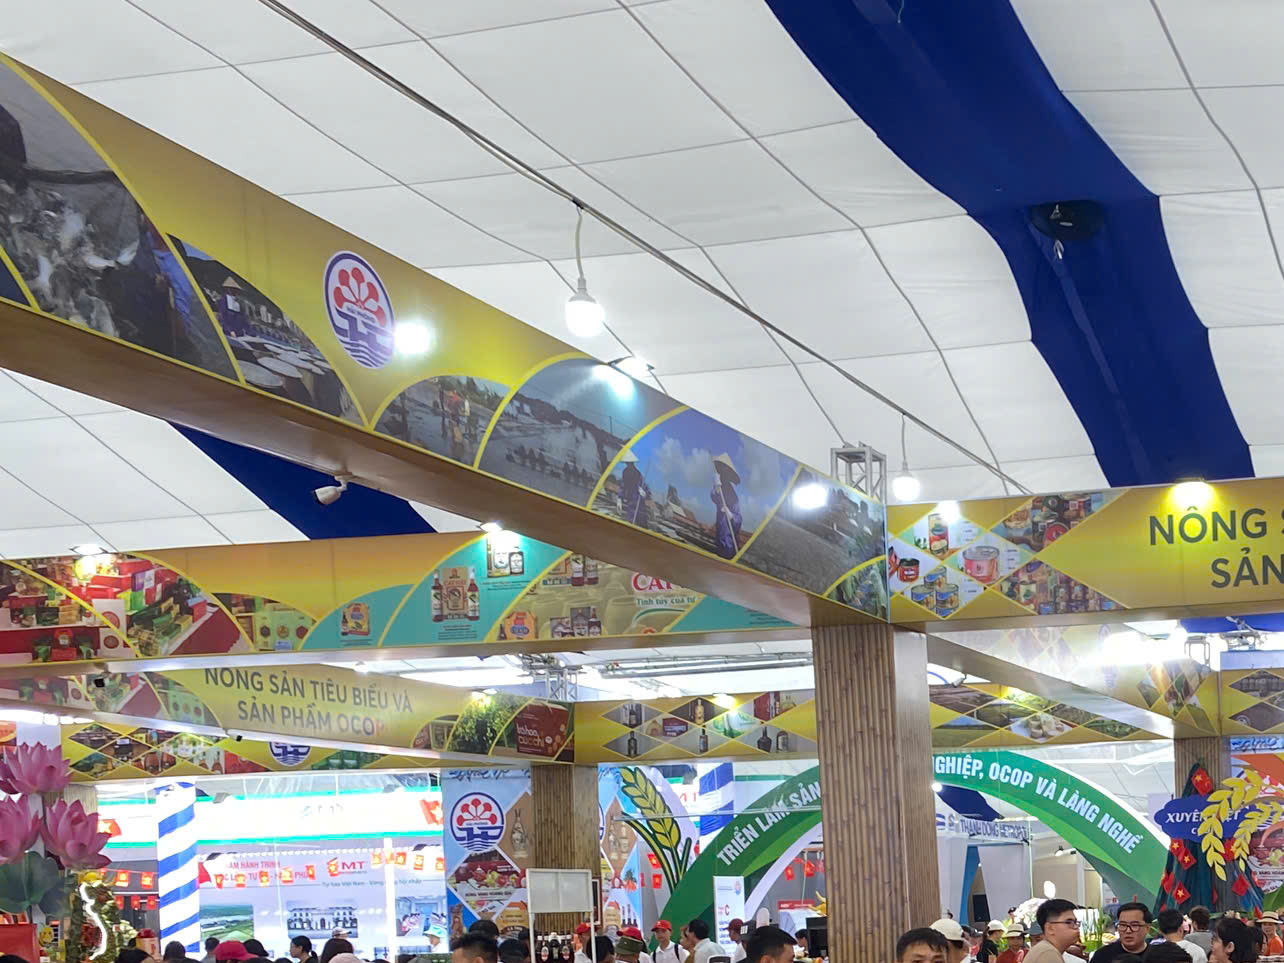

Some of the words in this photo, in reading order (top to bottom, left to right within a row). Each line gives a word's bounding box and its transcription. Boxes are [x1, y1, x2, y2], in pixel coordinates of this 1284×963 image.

[1149, 506, 1268, 545] NÔNG
[269, 670, 305, 698] SẢN
[310, 678, 348, 703] TIÊU
[352, 683, 388, 710] BIỂU
[392, 690, 413, 713] VÀ
[238, 696, 275, 725] SẢN
[281, 704, 332, 732] PHẨM
[716, 823, 760, 866] TRIỂN
[789, 782, 821, 809] SẢN
[989, 762, 1033, 789] OCOP
[1036, 777, 1057, 801] VÀ
[1057, 787, 1101, 822] LÀNG
[1099, 813, 1144, 854] NGHỀ
